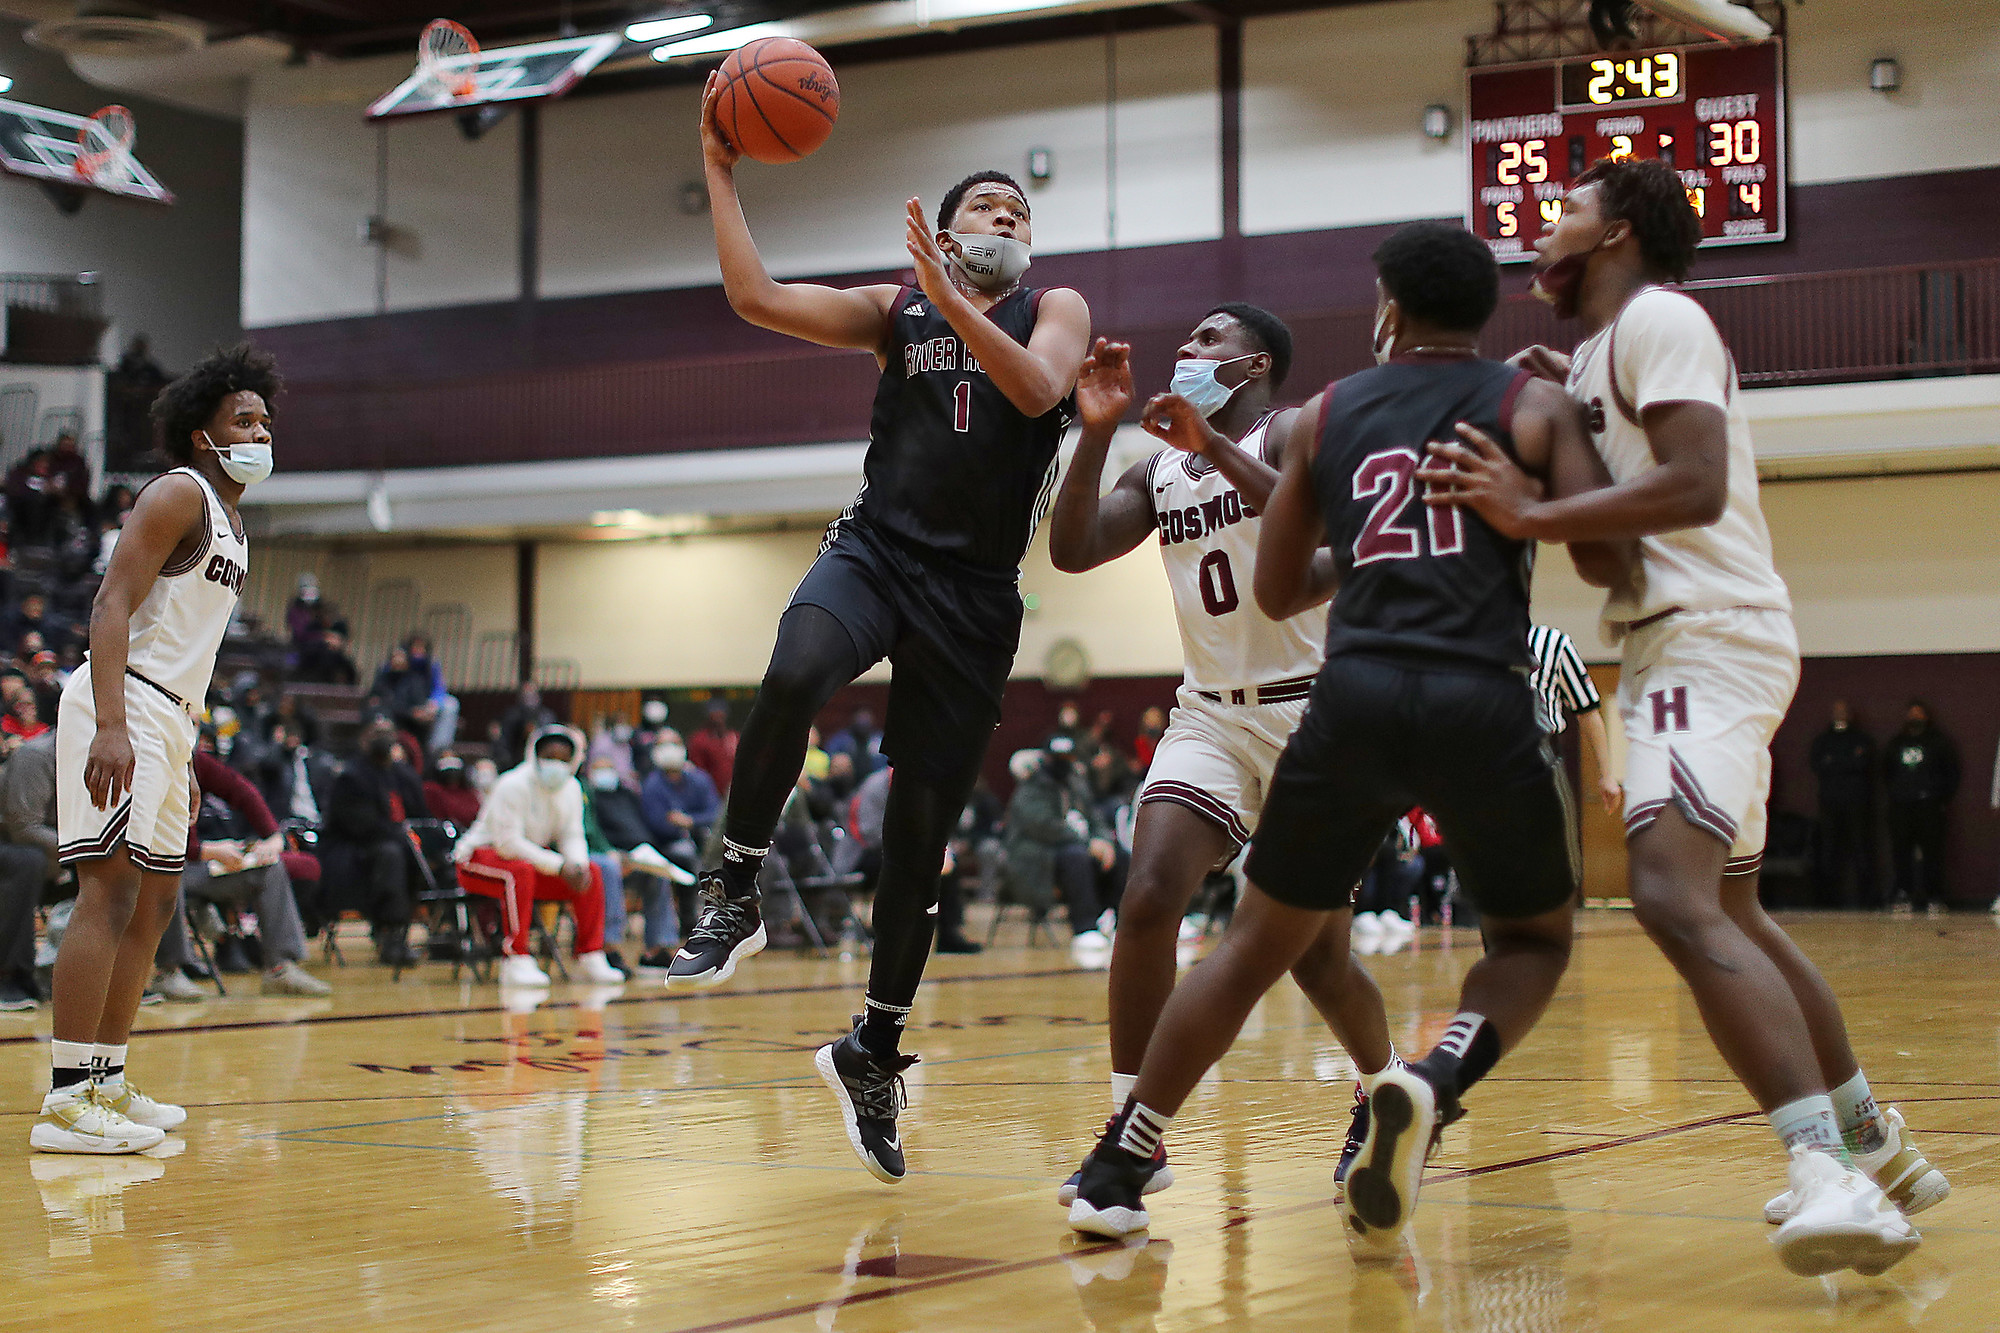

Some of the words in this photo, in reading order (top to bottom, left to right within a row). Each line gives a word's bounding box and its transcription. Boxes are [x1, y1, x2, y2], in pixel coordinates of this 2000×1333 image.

[1589, 53, 1678, 104] 2:43
[1472, 112, 1563, 143] PANTHERS
[1695, 94, 1759, 123] GUEST
[1498, 140, 1548, 185] 25
[1709, 120, 1760, 166] 30
[1497, 202, 1518, 236] 5
[1739, 184, 1760, 213] 4
[904, 337, 956, 379] RIVER
[954, 381, 970, 432] 1
[1352, 449, 1463, 567] 21
[1199, 549, 1239, 617] 0
[1647, 686, 1690, 735] H
